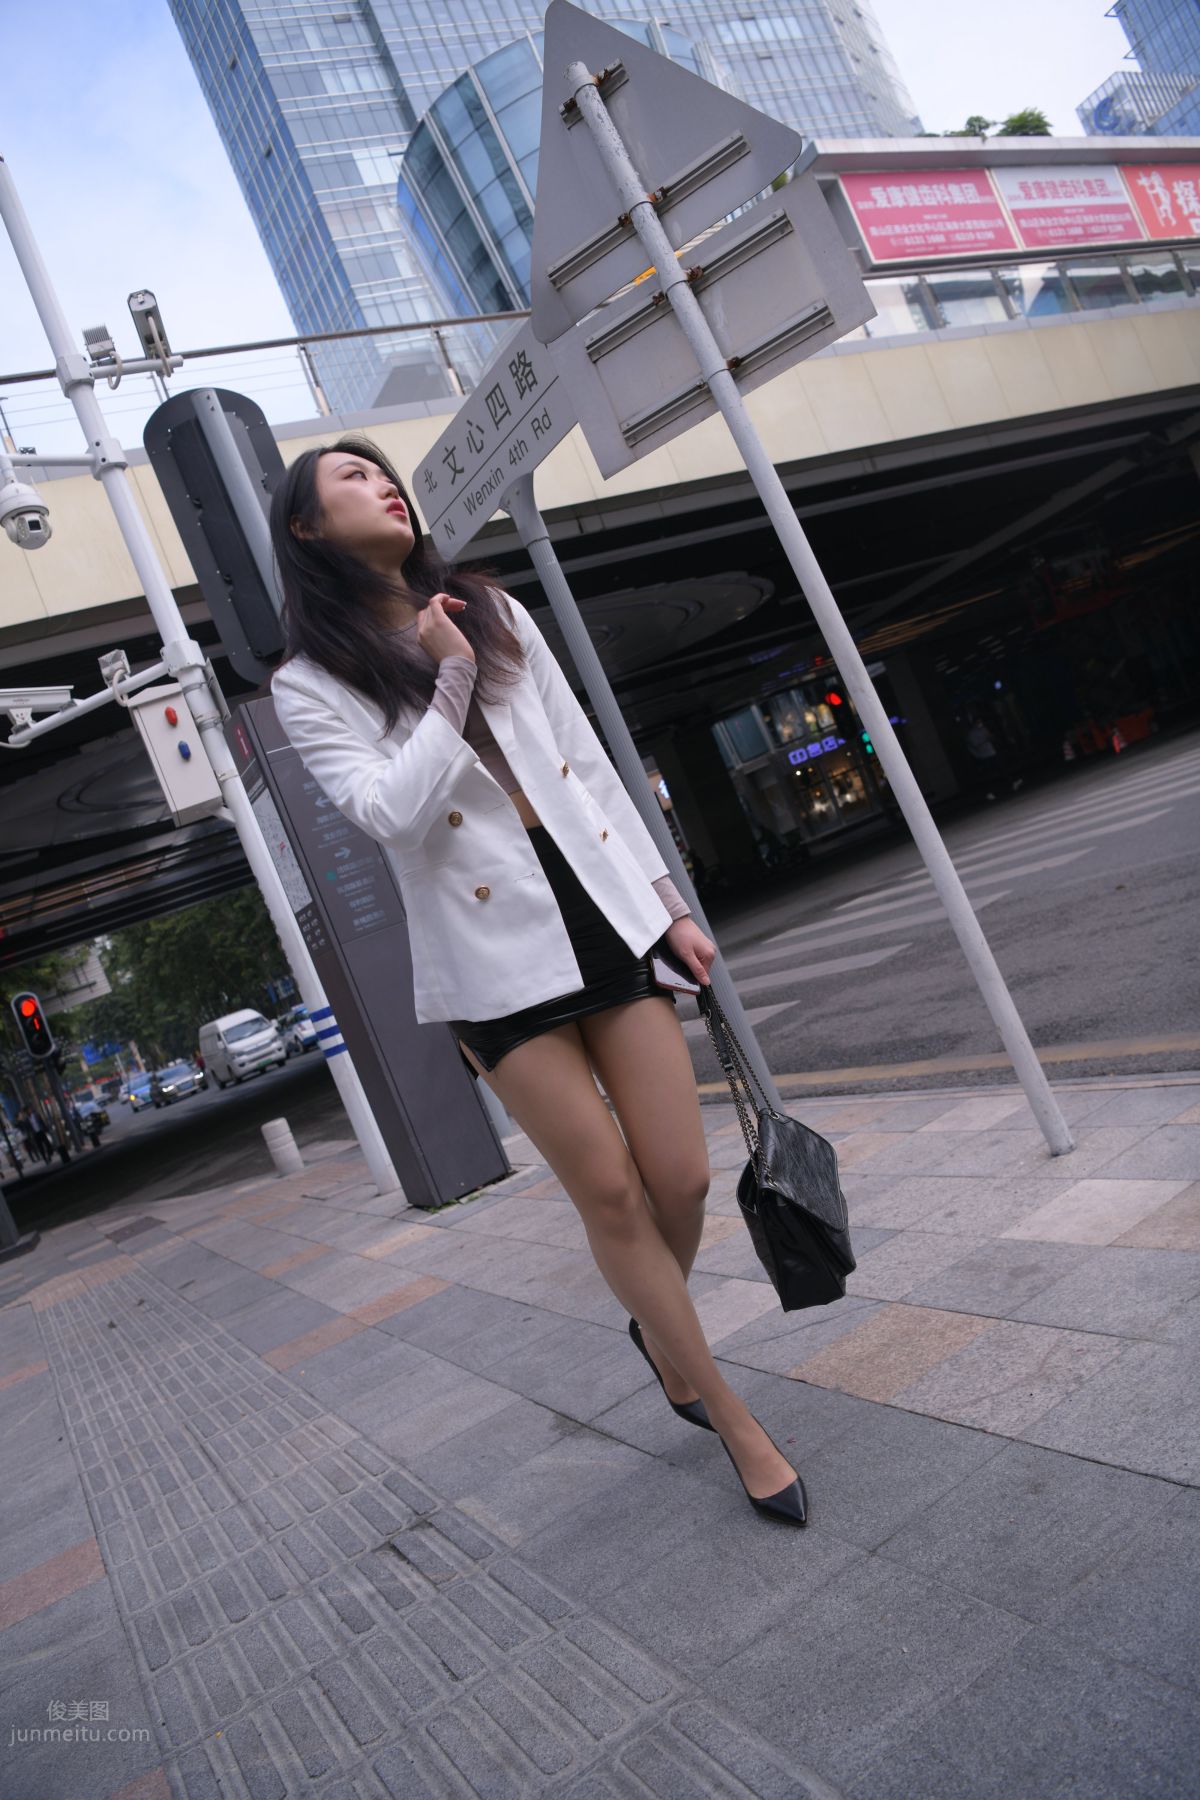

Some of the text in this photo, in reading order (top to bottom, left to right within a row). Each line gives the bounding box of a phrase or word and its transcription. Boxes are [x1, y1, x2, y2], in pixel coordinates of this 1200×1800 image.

[424, 350, 538, 494] 北 文心四路
[443, 407, 552, 540] N Wenxin 4th Rd
